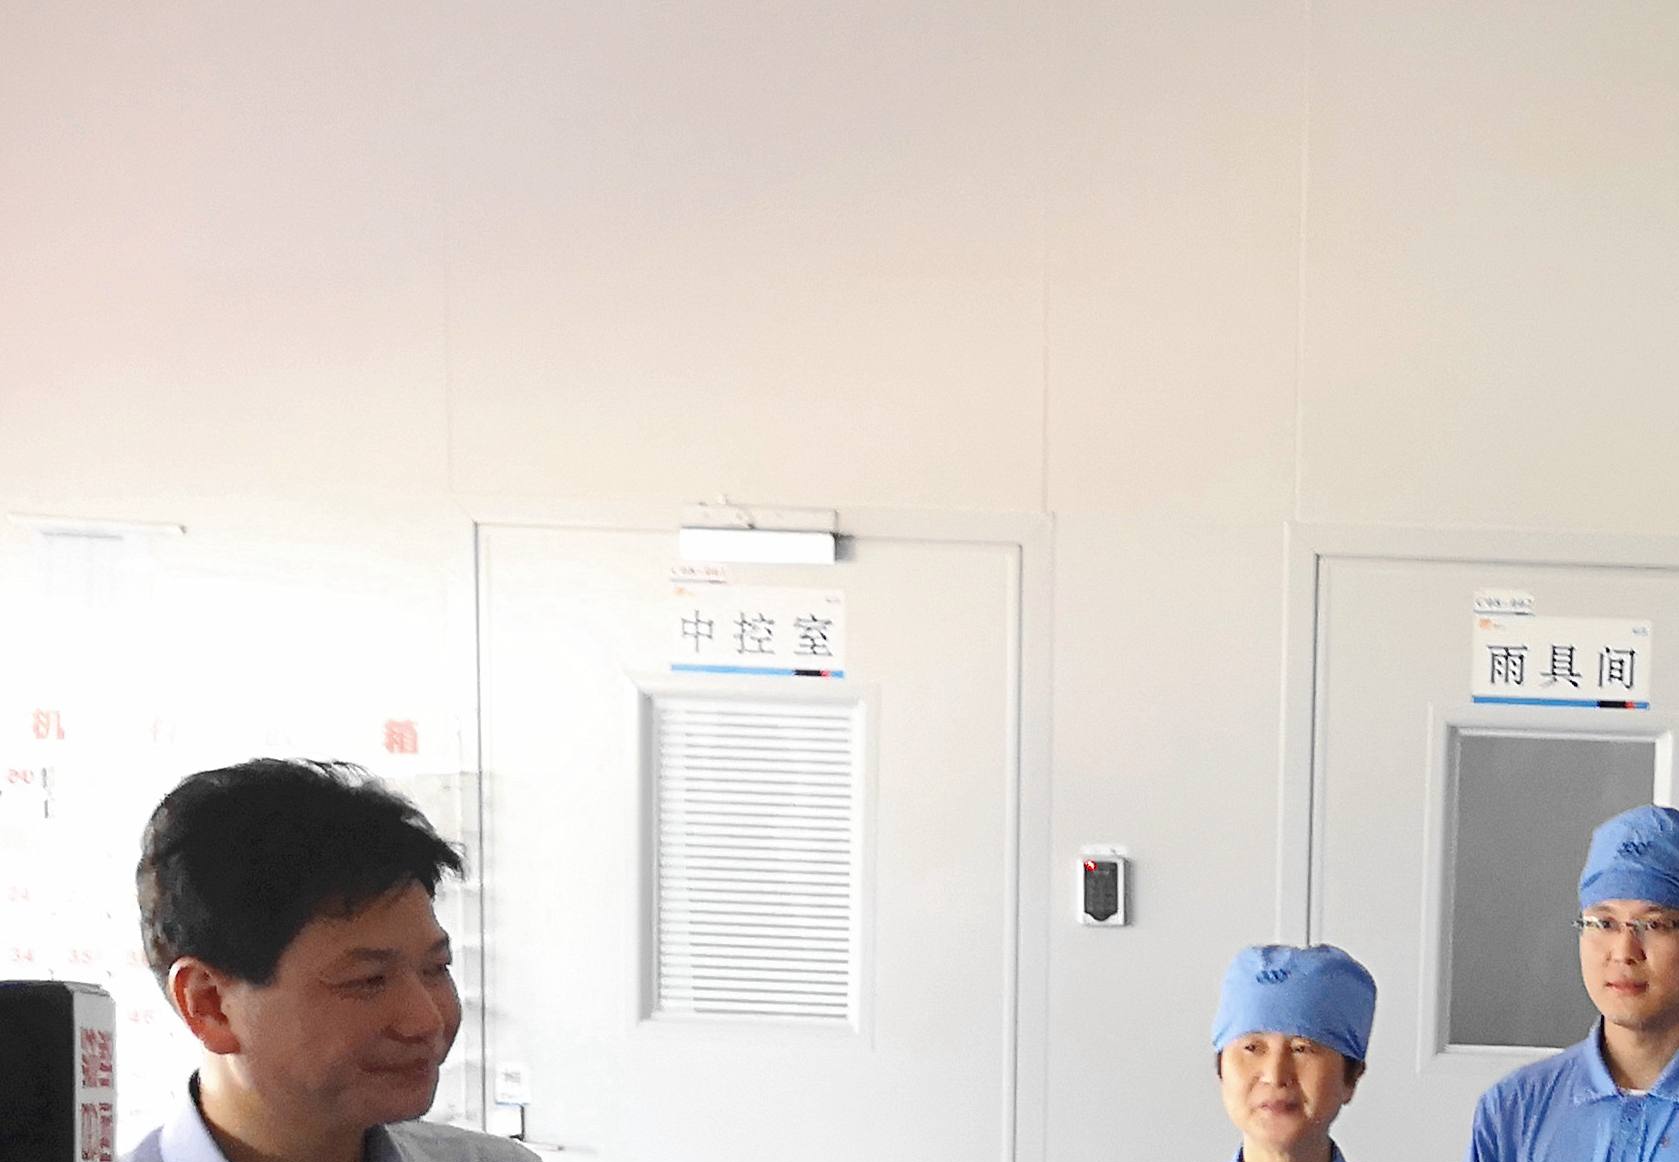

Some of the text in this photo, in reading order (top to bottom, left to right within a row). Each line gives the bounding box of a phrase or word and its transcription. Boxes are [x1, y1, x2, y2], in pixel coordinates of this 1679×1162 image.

[681, 610, 834, 656] 中控室
[1487, 645, 1636, 689] 雨具间
